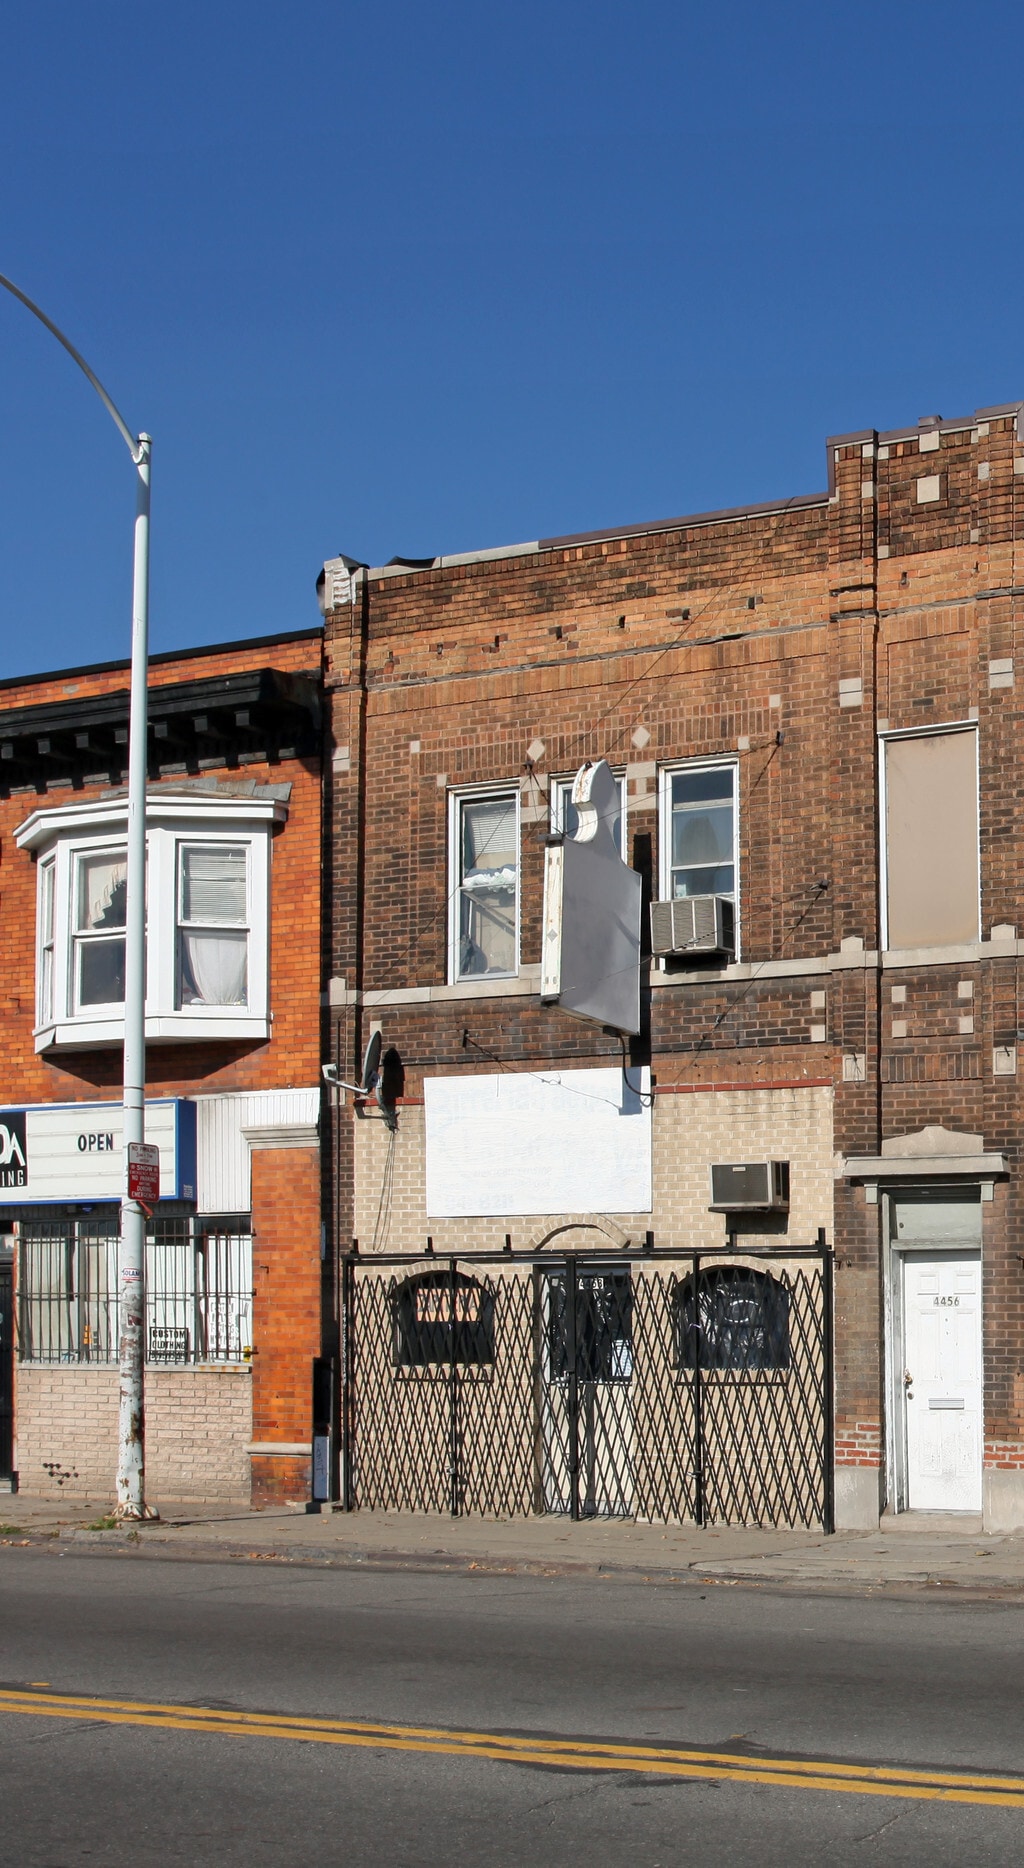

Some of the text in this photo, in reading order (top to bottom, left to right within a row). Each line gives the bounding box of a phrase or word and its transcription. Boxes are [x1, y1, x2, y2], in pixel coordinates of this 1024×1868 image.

[77, 1132, 114, 1152] OPEN
[136, 1164, 153, 1172] SNOW
[933, 1296, 960, 1307] 4456
[152, 1329, 185, 1338] CUSTOM
[152, 1340, 186, 1350] CLOTHNG
